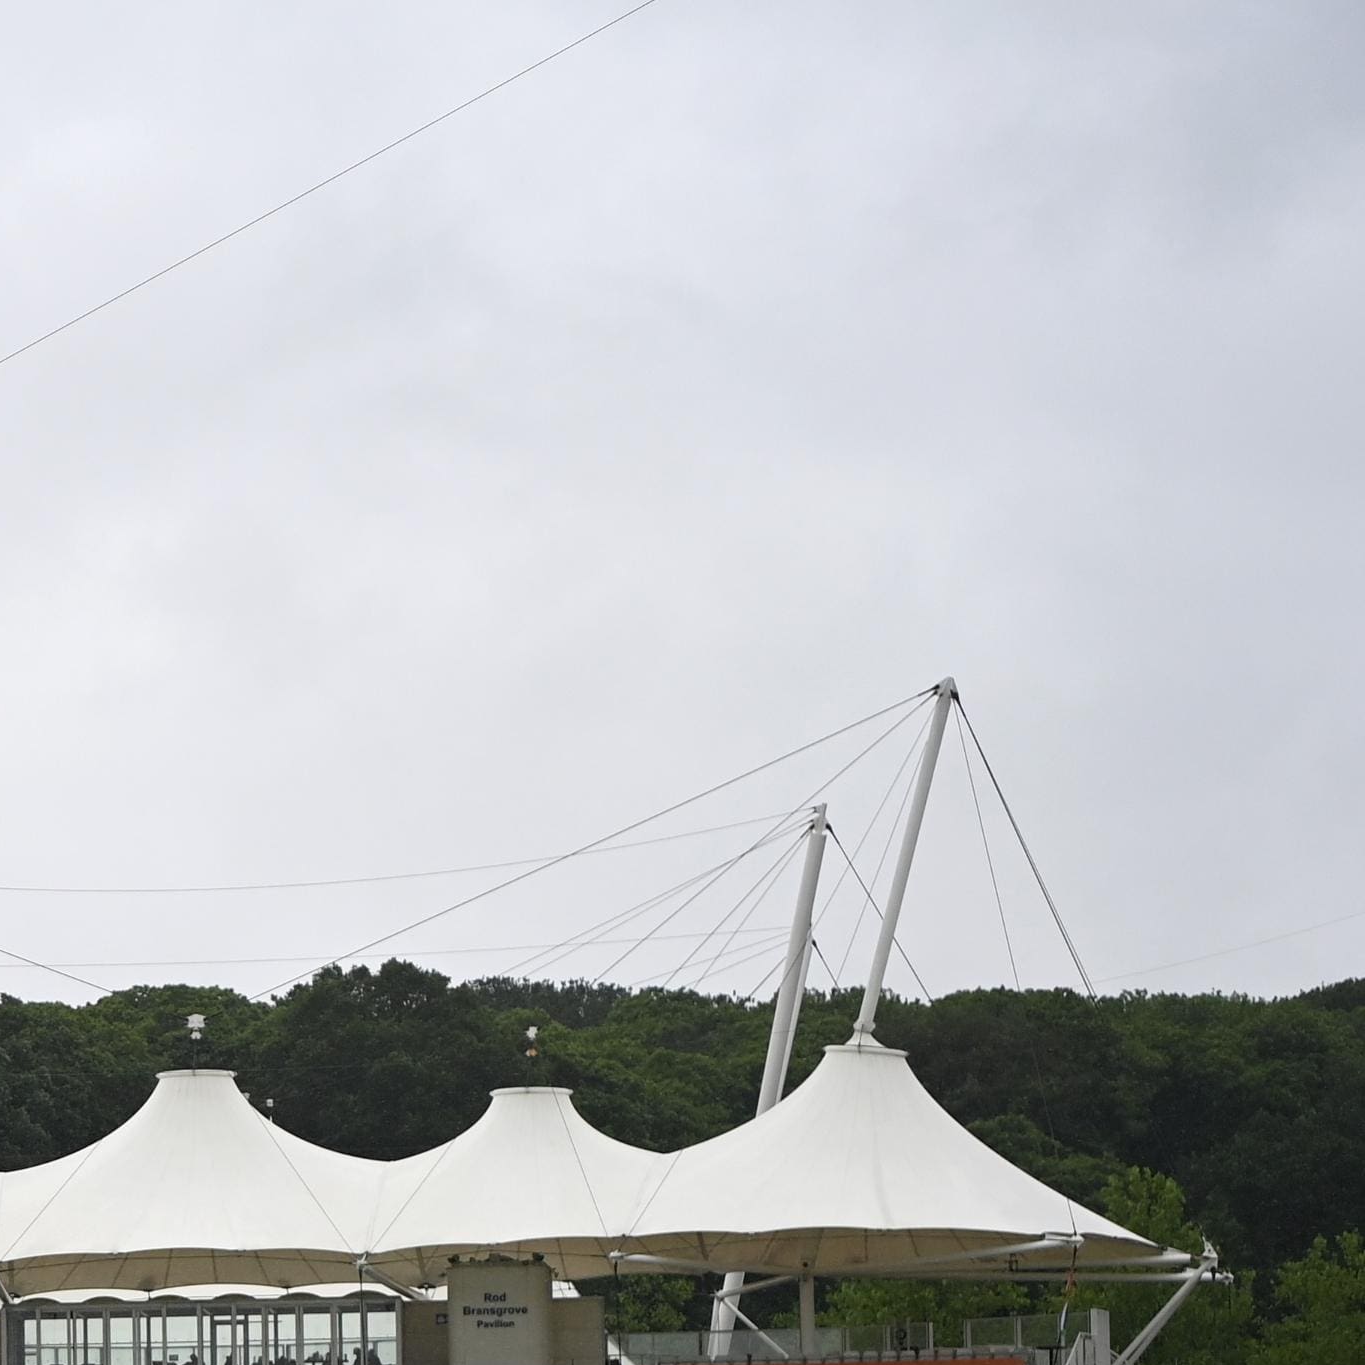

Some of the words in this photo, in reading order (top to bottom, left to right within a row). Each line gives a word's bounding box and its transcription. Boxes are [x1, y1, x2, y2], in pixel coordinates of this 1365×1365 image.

[484, 1292, 506, 1302] Rod
[463, 1306, 528, 1317] Bransgrove
[477, 1320, 515, 1328] Pavilion
